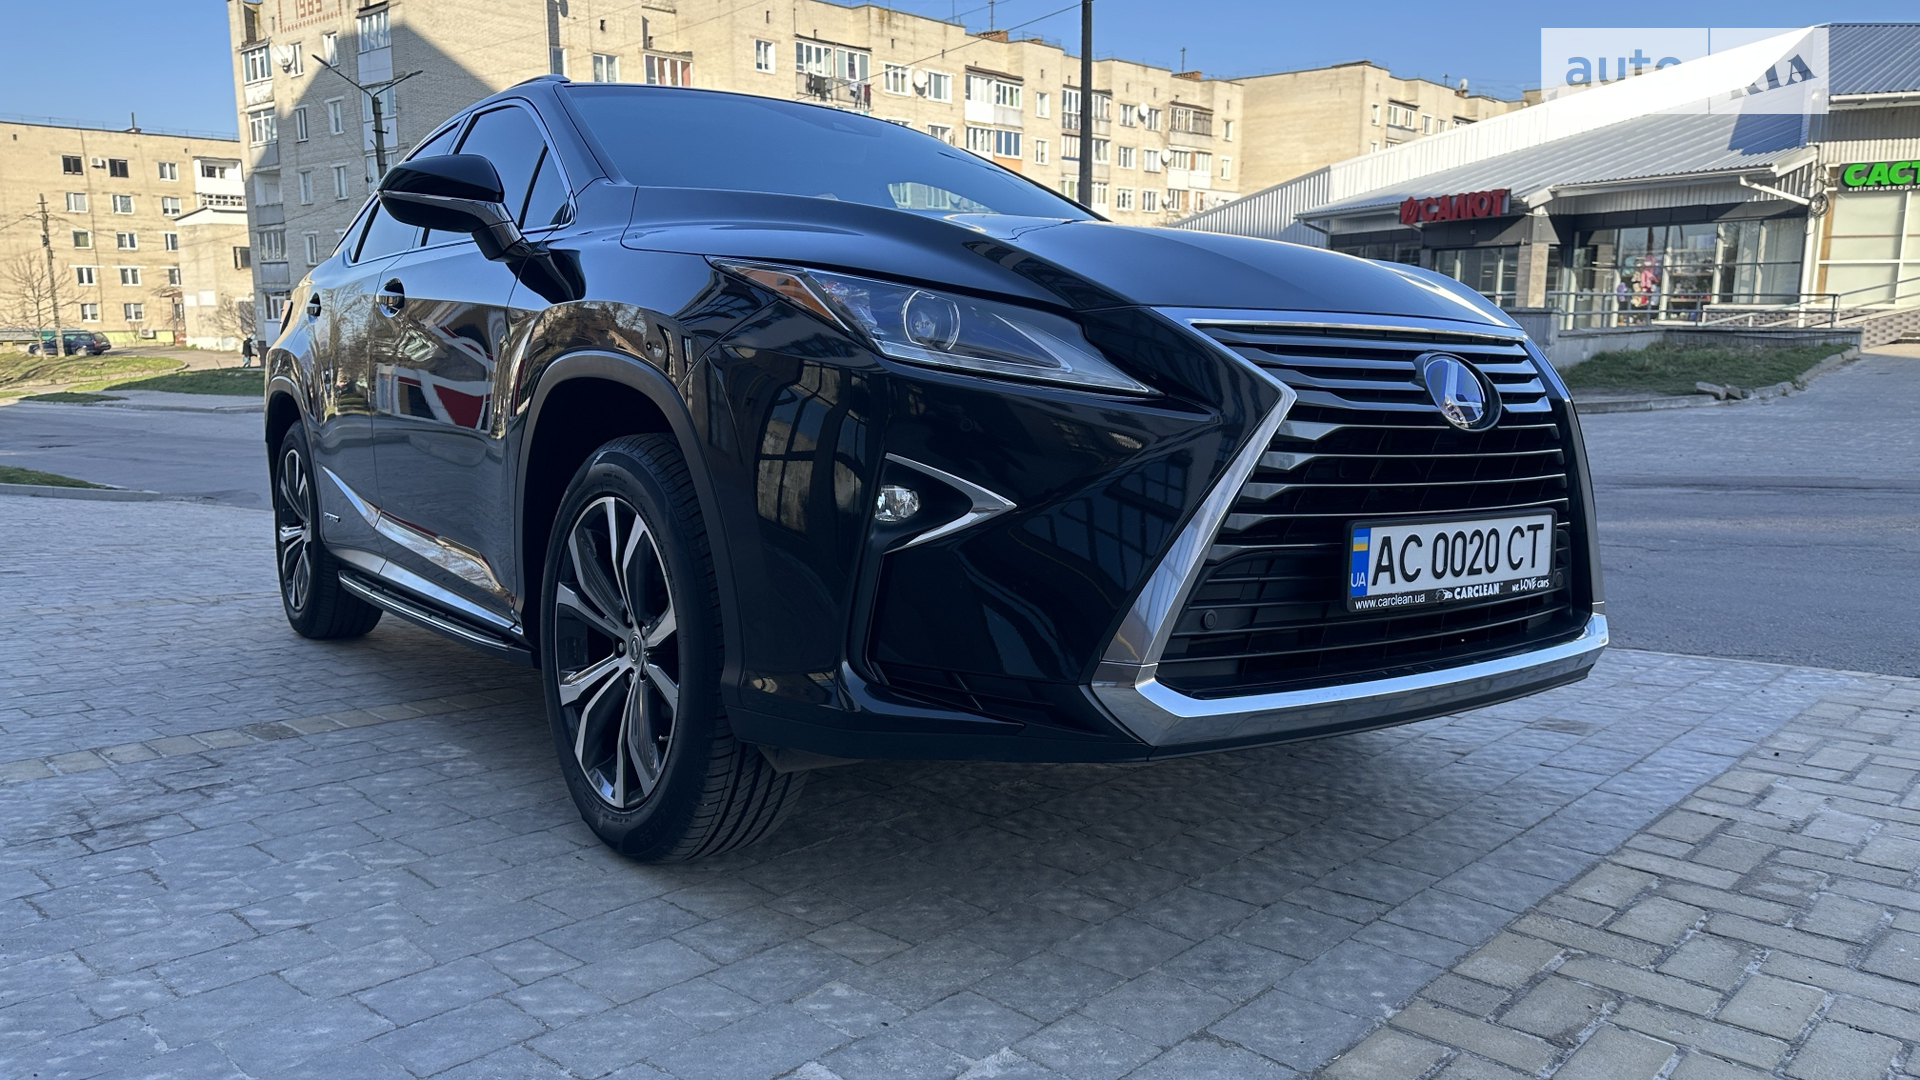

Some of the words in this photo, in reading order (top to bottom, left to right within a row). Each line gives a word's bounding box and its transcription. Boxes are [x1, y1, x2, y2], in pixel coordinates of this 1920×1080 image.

[1421, 188, 1506, 222] САЛЮТ
[1371, 533, 1423, 586] AC
[1431, 527, 1500, 580] 0020
[1507, 523, 1545, 571] CT
[1350, 572, 1366, 588] UA
[1520, 577, 1537, 591] LOVE
[1537, 578, 1549, 588] cars
[1453, 583, 1500, 600] CARCLEAN
[1354, 592, 1425, 610] www.carclean.ua
